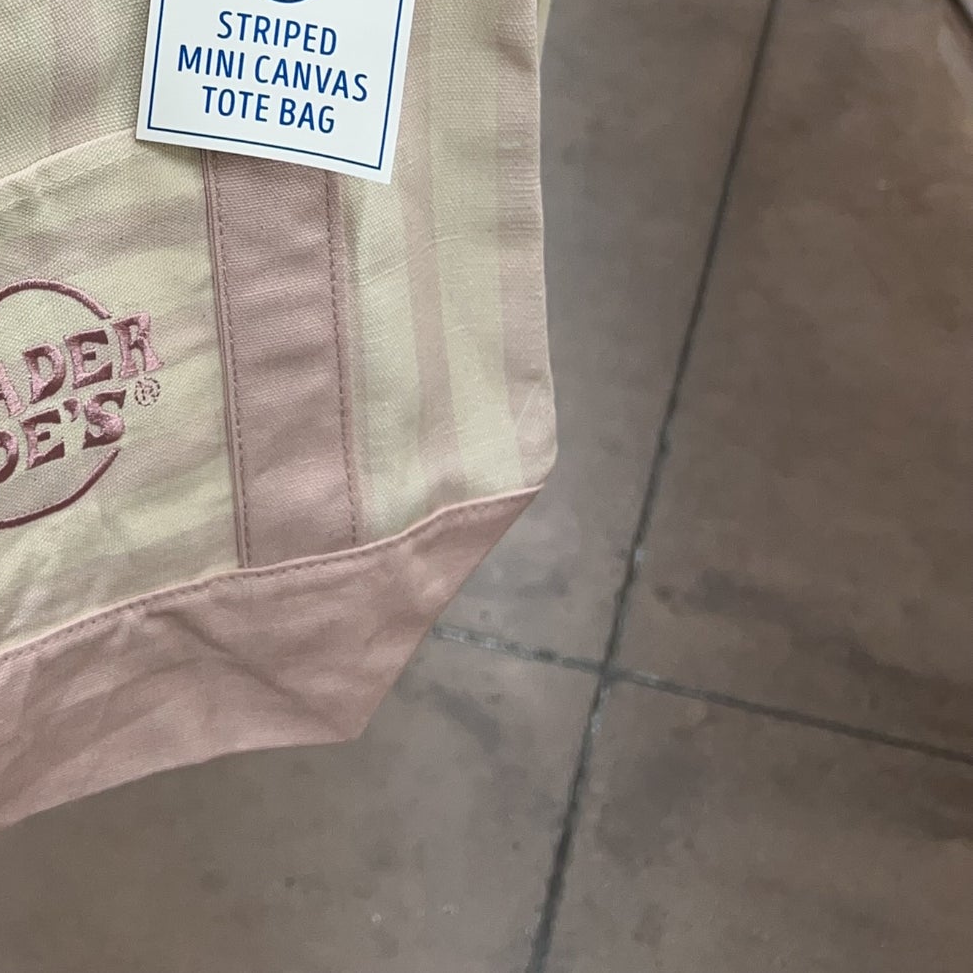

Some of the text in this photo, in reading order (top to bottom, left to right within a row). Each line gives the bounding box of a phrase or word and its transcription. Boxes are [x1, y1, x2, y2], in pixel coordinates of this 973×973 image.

[216, 10, 338, 56] STRIPED
[177, 44, 368, 103] MINI CANVAS
[202, 85, 336, 134] TOTE BAG
